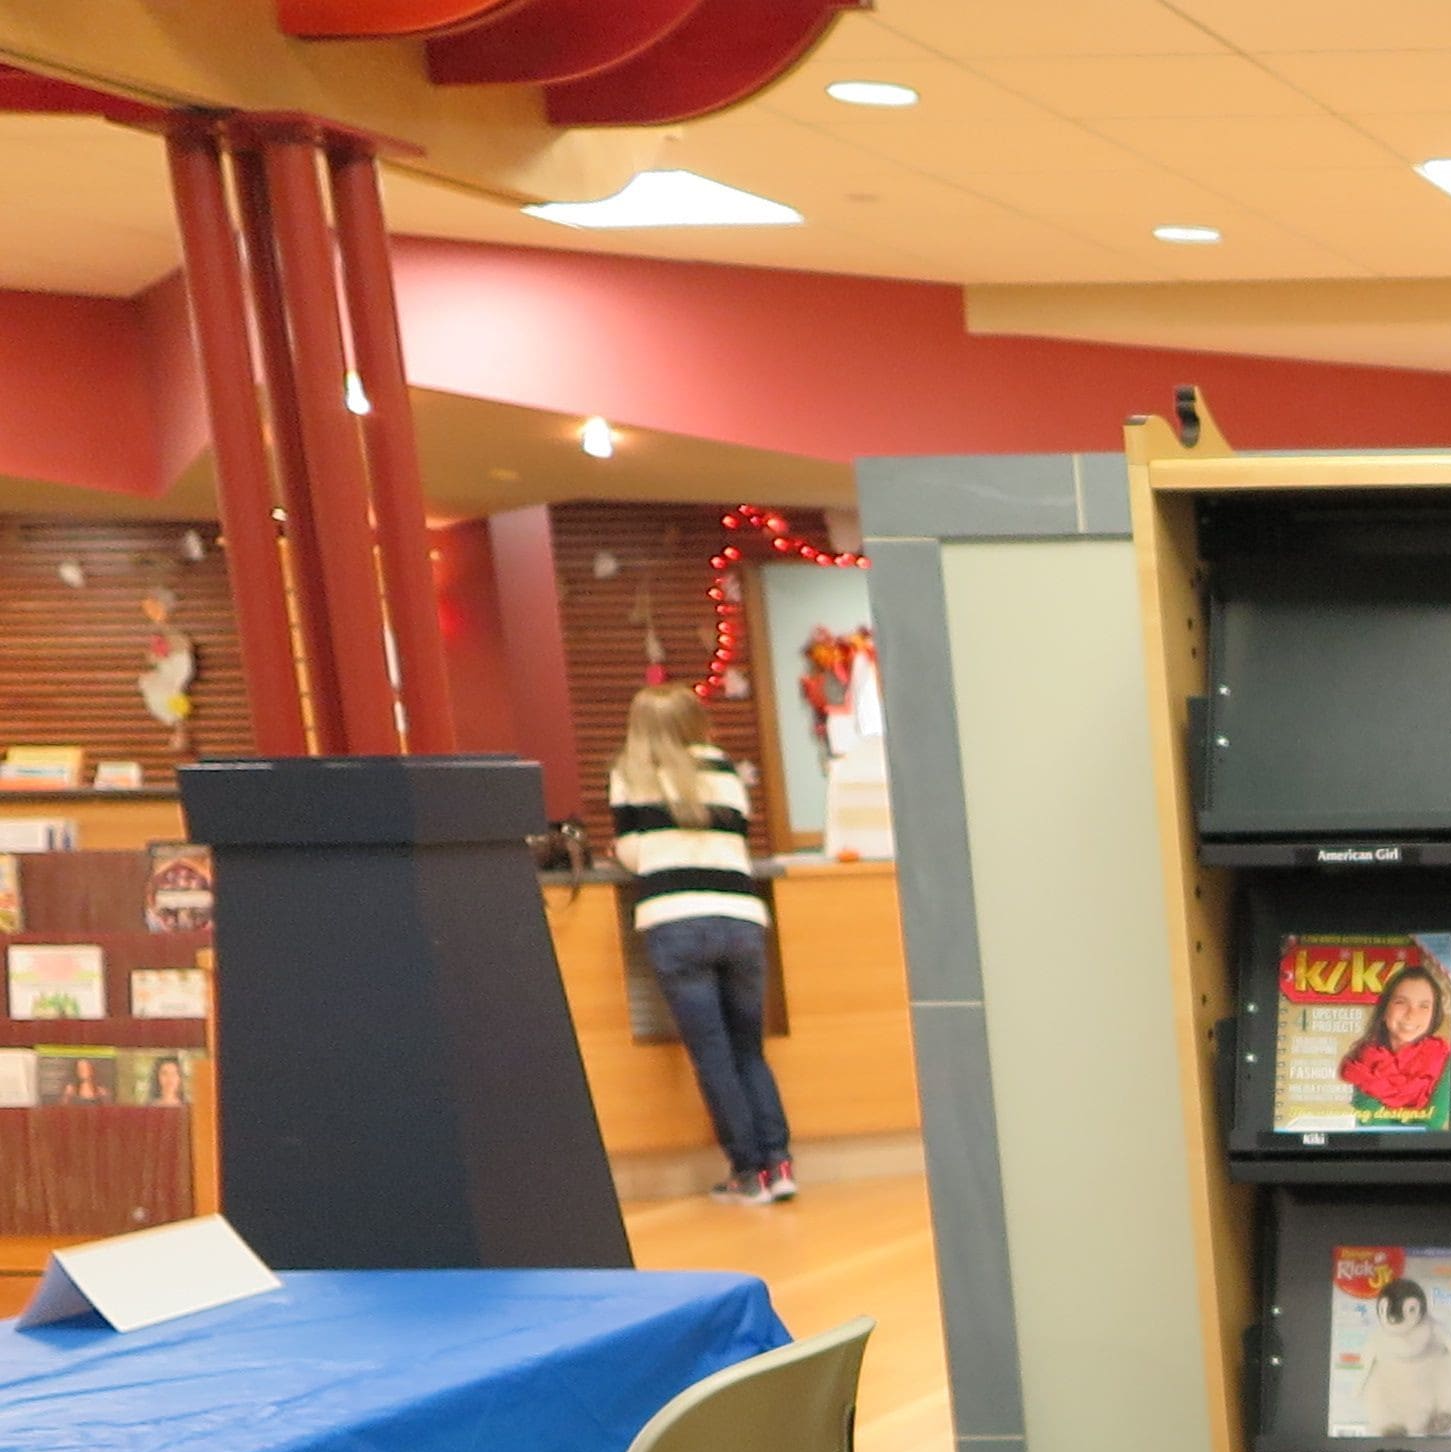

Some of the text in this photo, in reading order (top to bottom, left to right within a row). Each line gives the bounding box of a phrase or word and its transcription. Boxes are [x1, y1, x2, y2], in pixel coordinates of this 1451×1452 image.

[1318, 848, 1399, 862] American Girl
[1303, 1132, 1325, 1145] Kiki
